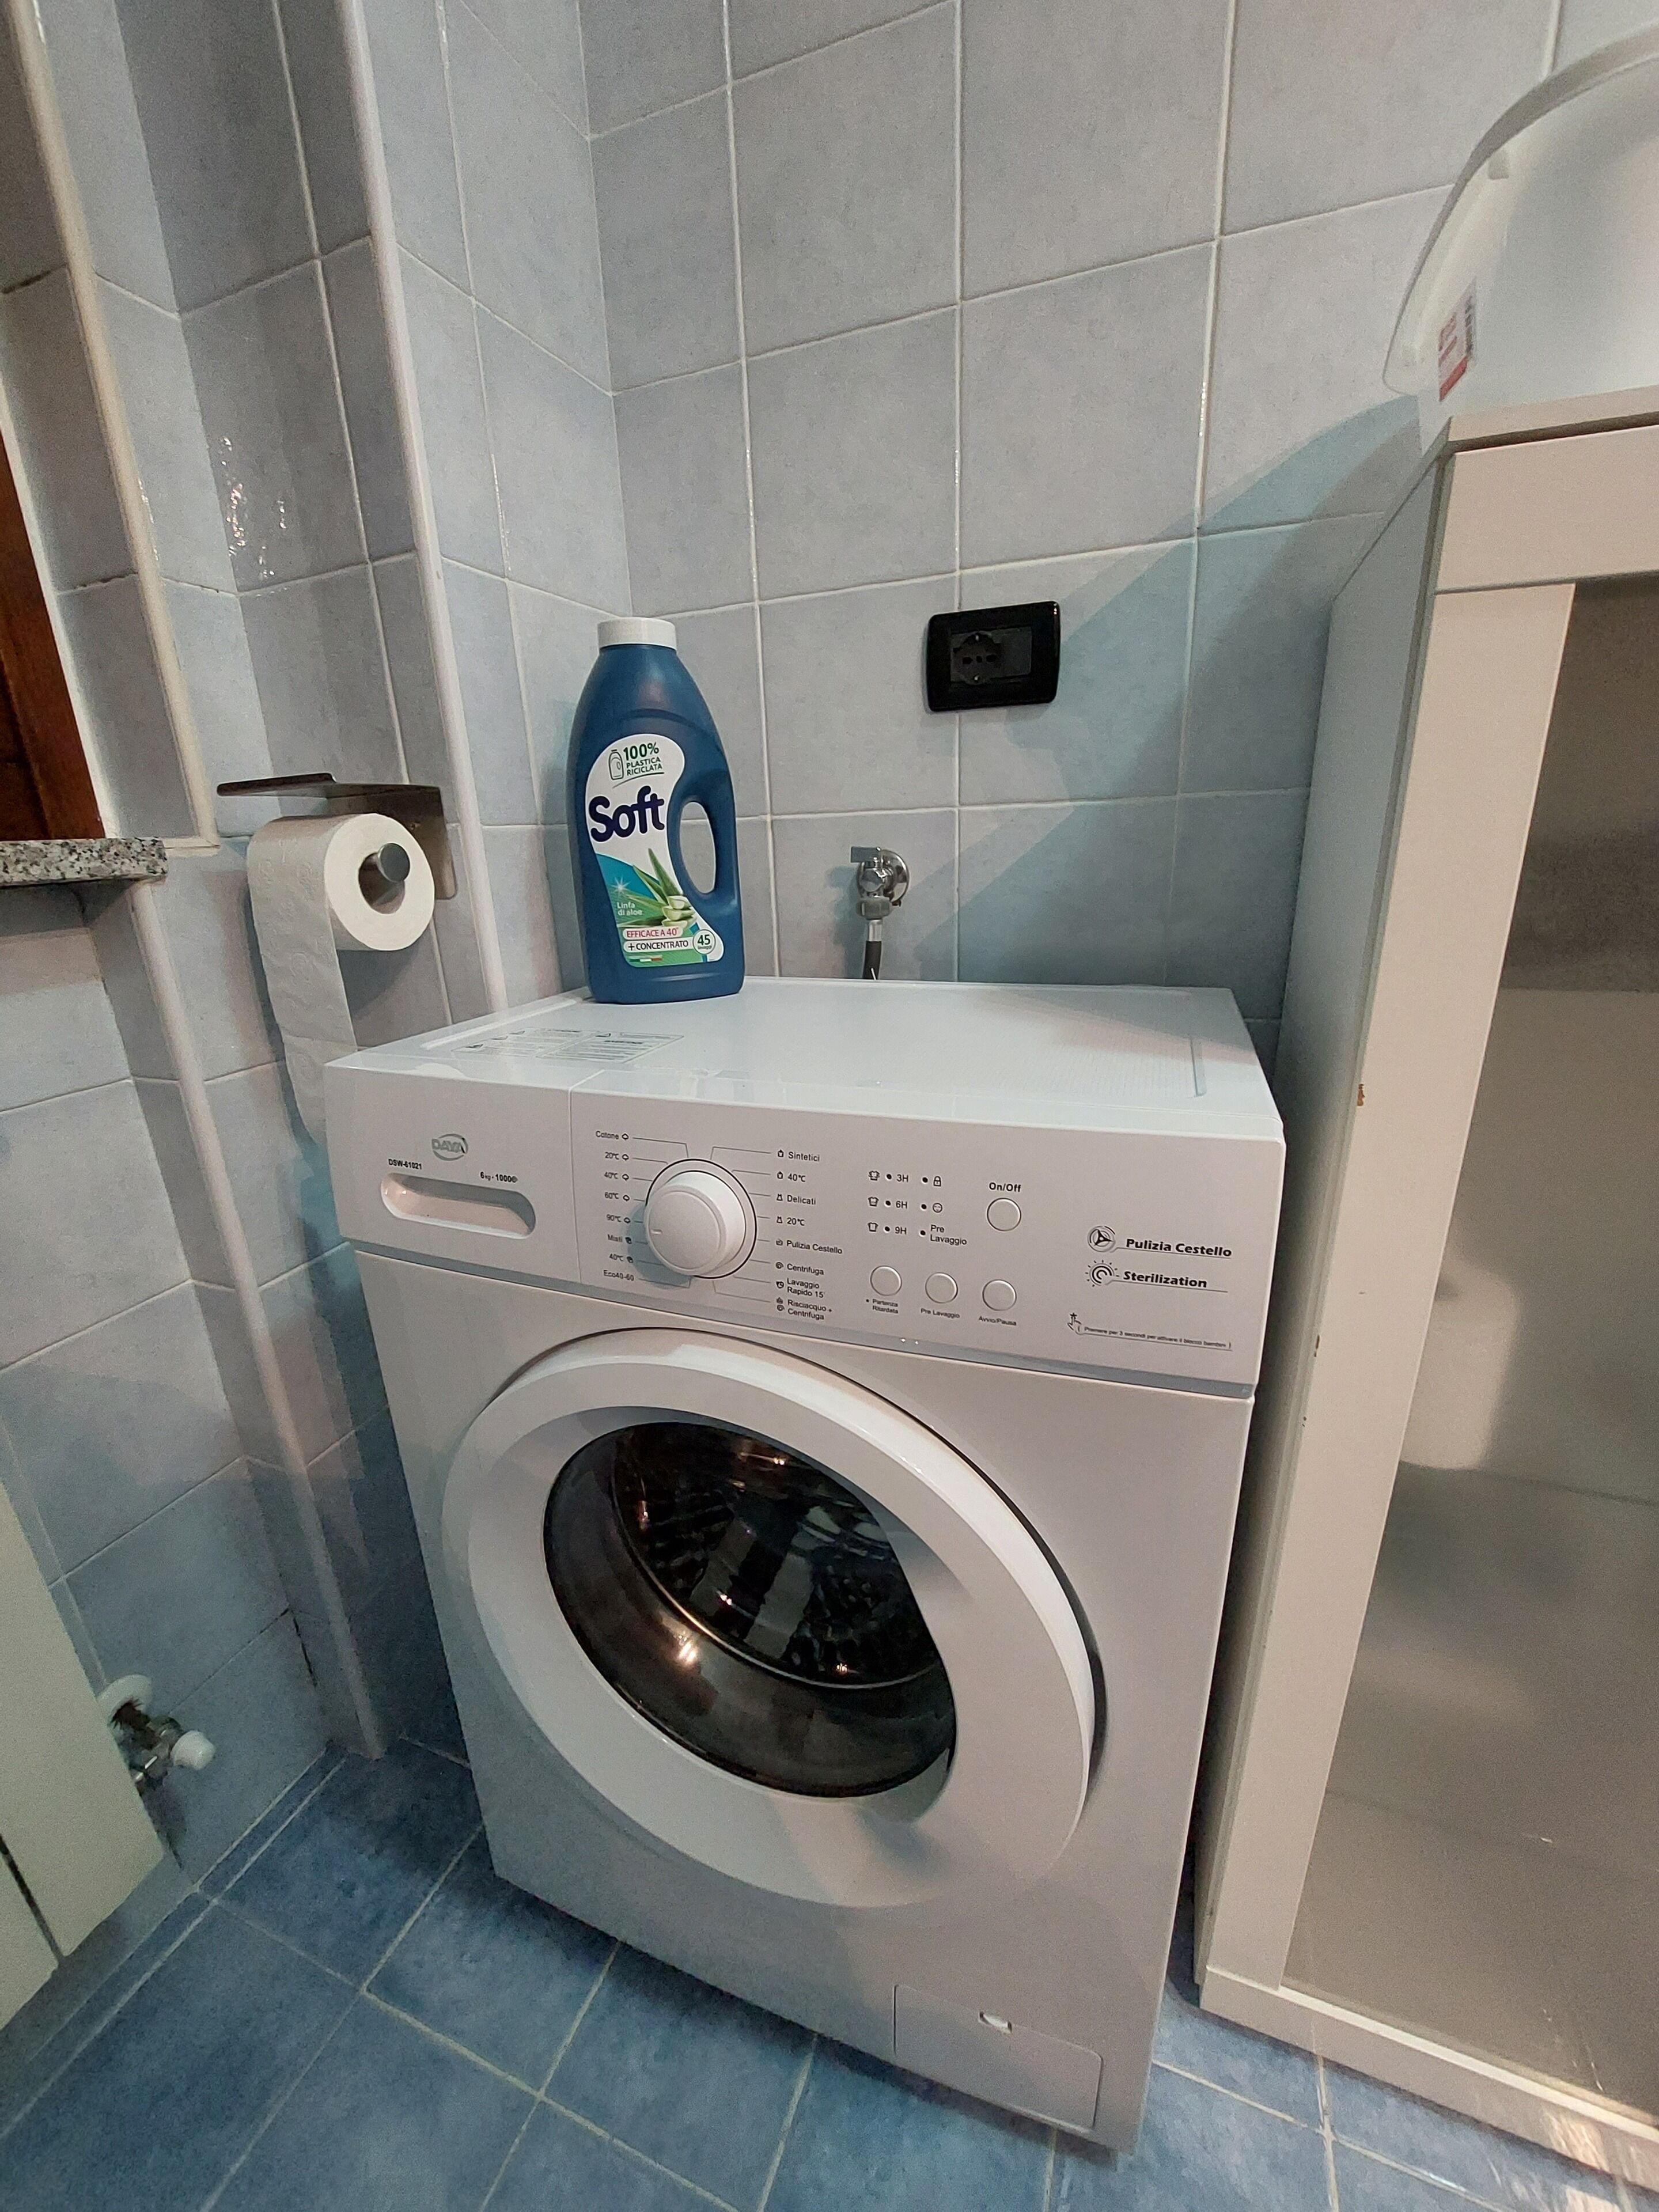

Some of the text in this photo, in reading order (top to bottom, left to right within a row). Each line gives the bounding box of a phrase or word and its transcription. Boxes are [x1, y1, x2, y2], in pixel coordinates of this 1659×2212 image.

[623, 742, 659, 761] 100%
[627, 756, 661, 768] PLASTICA
[627, 763, 662, 776] RICICLATA
[589, 785, 665, 842] Soft
[627, 930, 659, 938] EFFICACE
[667, 927, 679, 936] 40°
[636, 940, 688, 950] CONCENTRATO
[698, 934, 710, 945] 45
[788, 1152, 820, 1162] Sintetici
[788, 1173, 806, 1182] 40°C
[897, 1174, 908, 1182] 3H
[989, 1182, 1021, 1192] On/Off
[787, 1195, 816, 1205] Delicati
[896, 1201, 908, 1209] 6H
[787, 1217, 805, 1226] 20°C
[895, 1226, 907, 1234] 9H
[930, 1225, 944, 1233] Pre
[930, 1234, 967, 1246] Lavaggio
[787, 1240, 842, 1254] Pulizia Cestello
[1126, 1238, 1232, 1257] Pulizia Cestello
[787, 1263, 824, 1276] Centrifuga
[787, 1278, 820, 1289] Lavaggio
[1123, 1271, 1207, 1288] Sterilization
[787, 1286, 812, 1297] Rapido
[787, 1299, 827, 1312] Risciacquo
[787, 1308, 824, 1320] Centrifuga
[933, 1310, 960, 1319] Lavaggio
